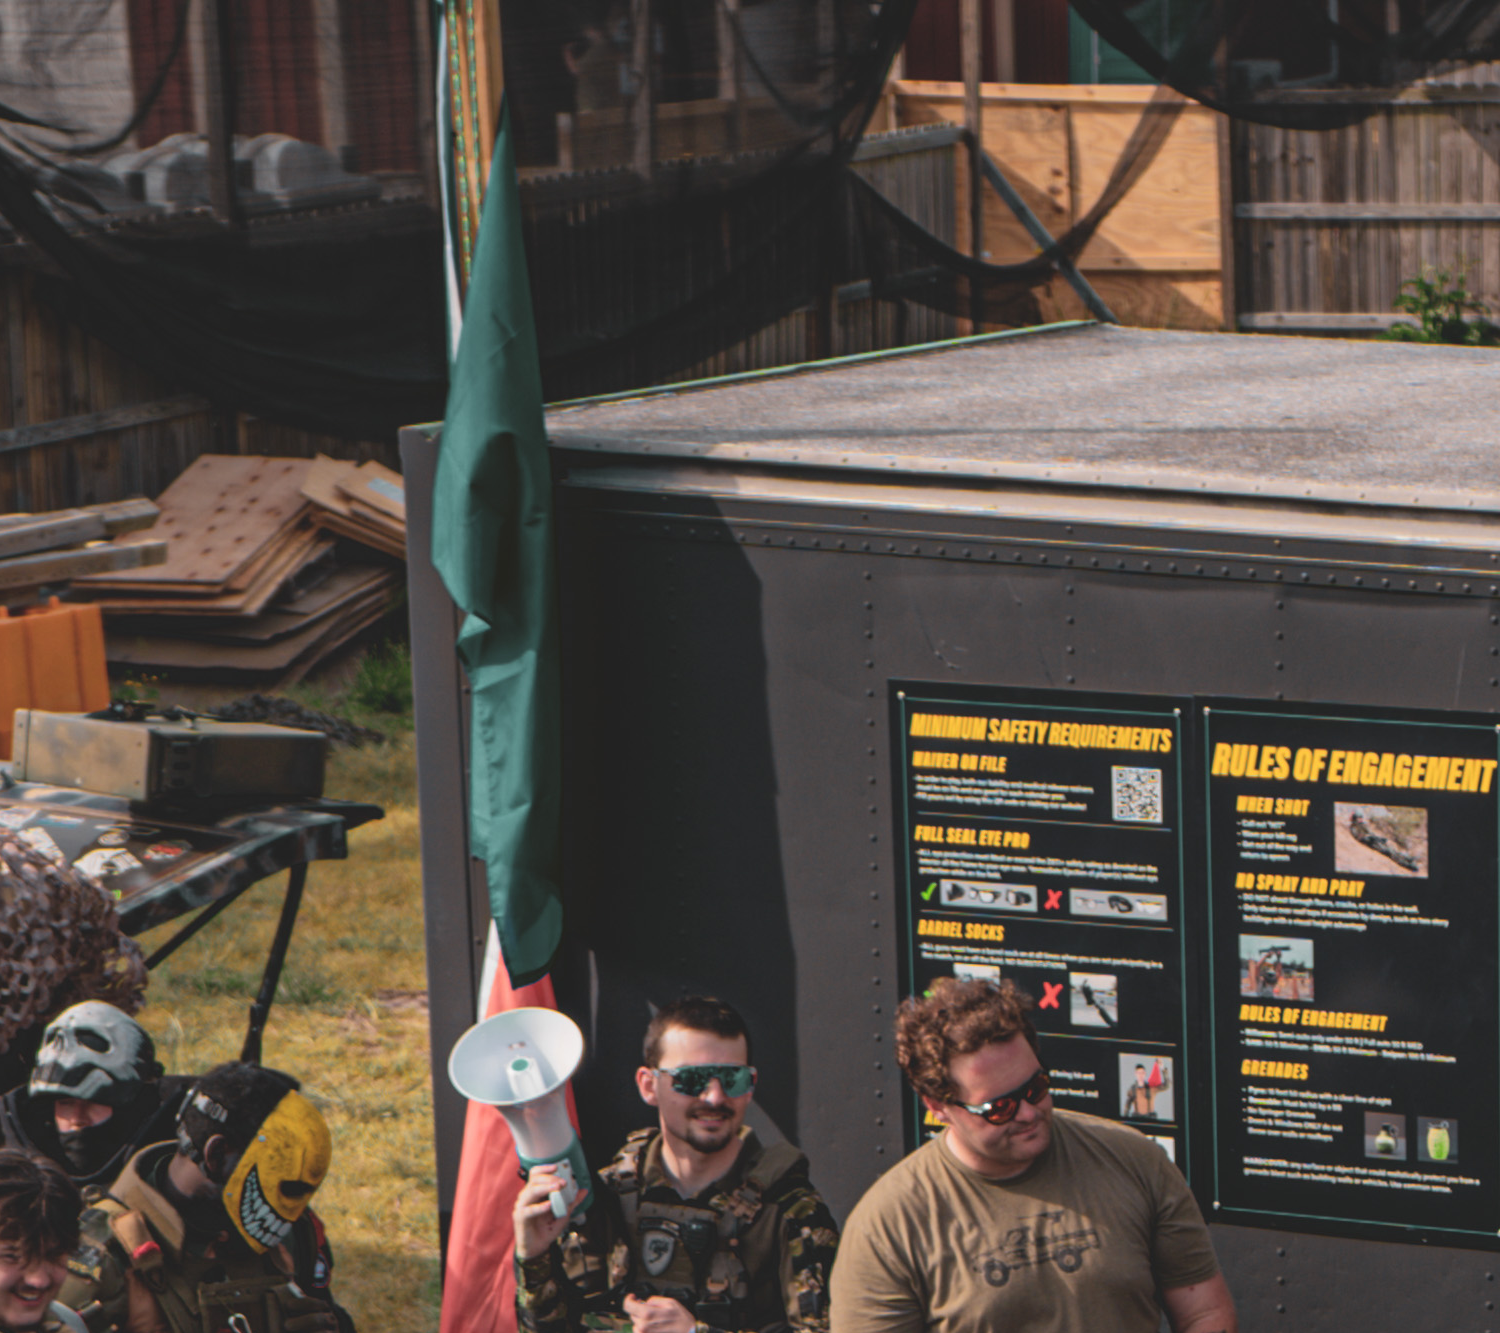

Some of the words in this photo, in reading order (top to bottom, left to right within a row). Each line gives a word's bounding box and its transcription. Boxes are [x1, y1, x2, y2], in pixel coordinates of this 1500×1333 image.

[910, 713, 988, 740] MINIMUM
[988, 719, 1049, 744] SAFETY
[1048, 722, 1173, 752] REQUIREMENTS
[1212, 742, 1292, 780] RULES
[1293, 748, 1328, 782] OF
[1327, 750, 1498, 793] ENGAGEMENT
[1241, 1059, 1309, 1080] GRENADES
